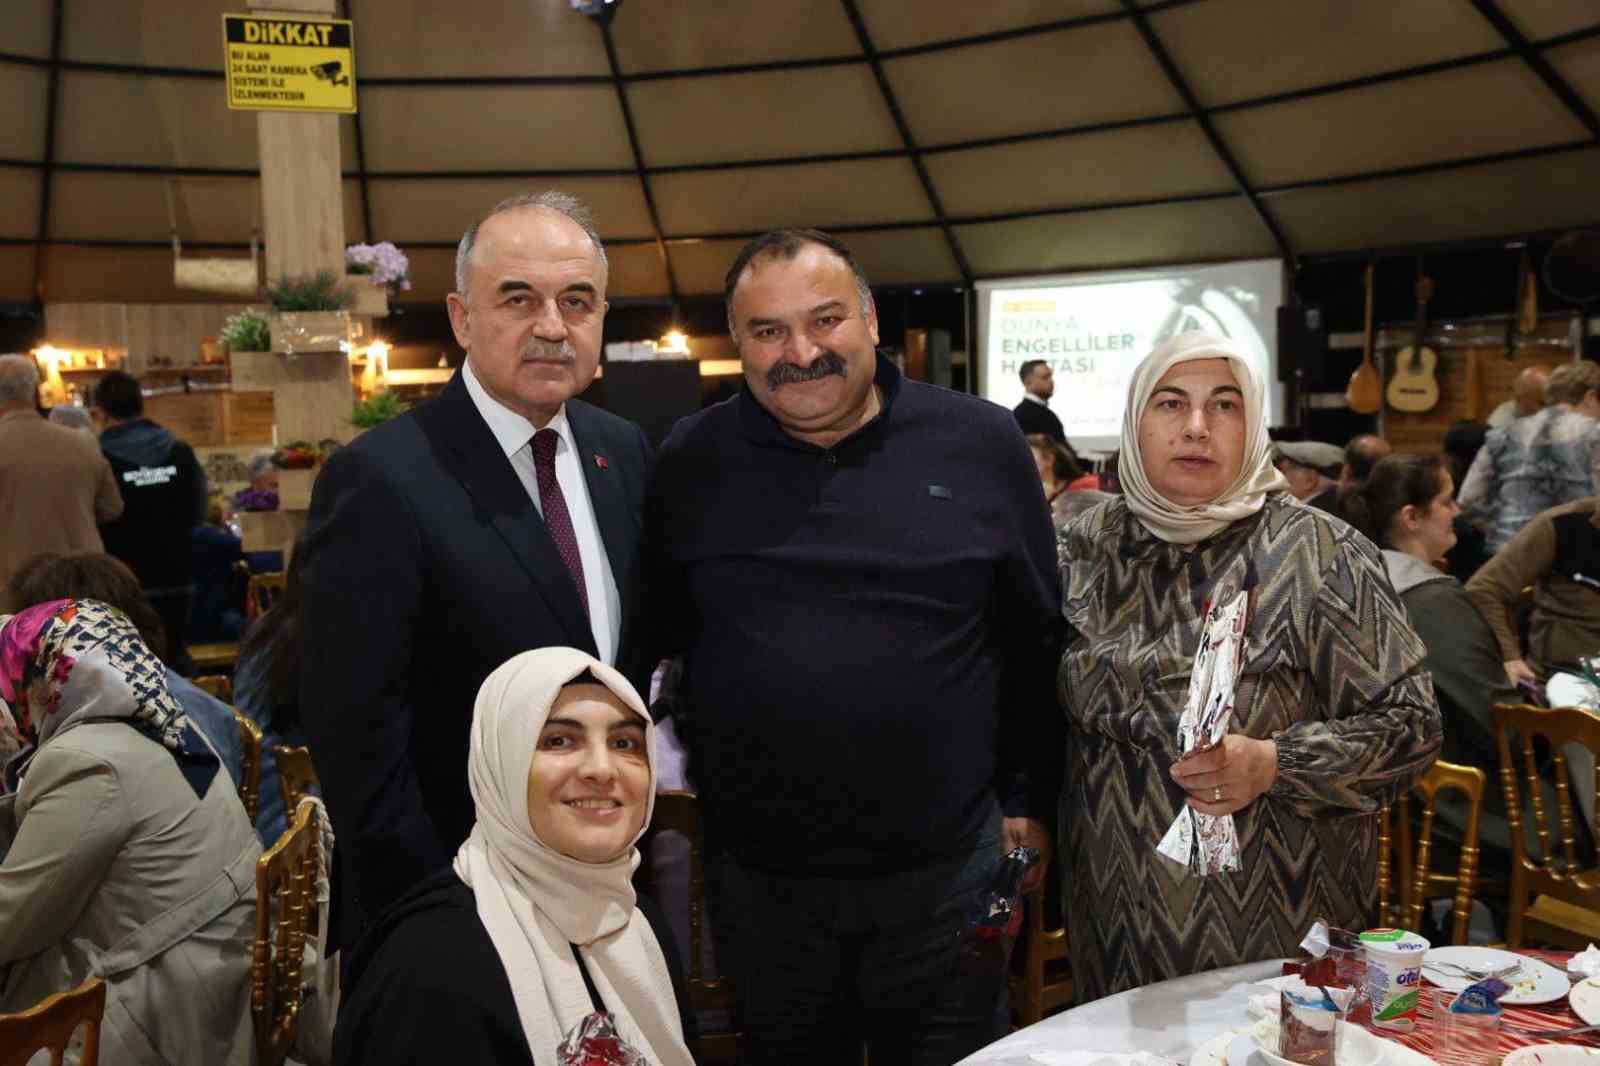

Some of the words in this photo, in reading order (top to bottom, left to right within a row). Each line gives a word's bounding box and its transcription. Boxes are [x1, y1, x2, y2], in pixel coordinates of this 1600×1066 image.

[247, 51, 270, 61] ALAN
[245, 64, 267, 74] SAAT
[271, 65, 308, 75] KAMERA
[1002, 333, 1135, 353] ENGELLİLER
[1001, 358, 1095, 375] HTASI
